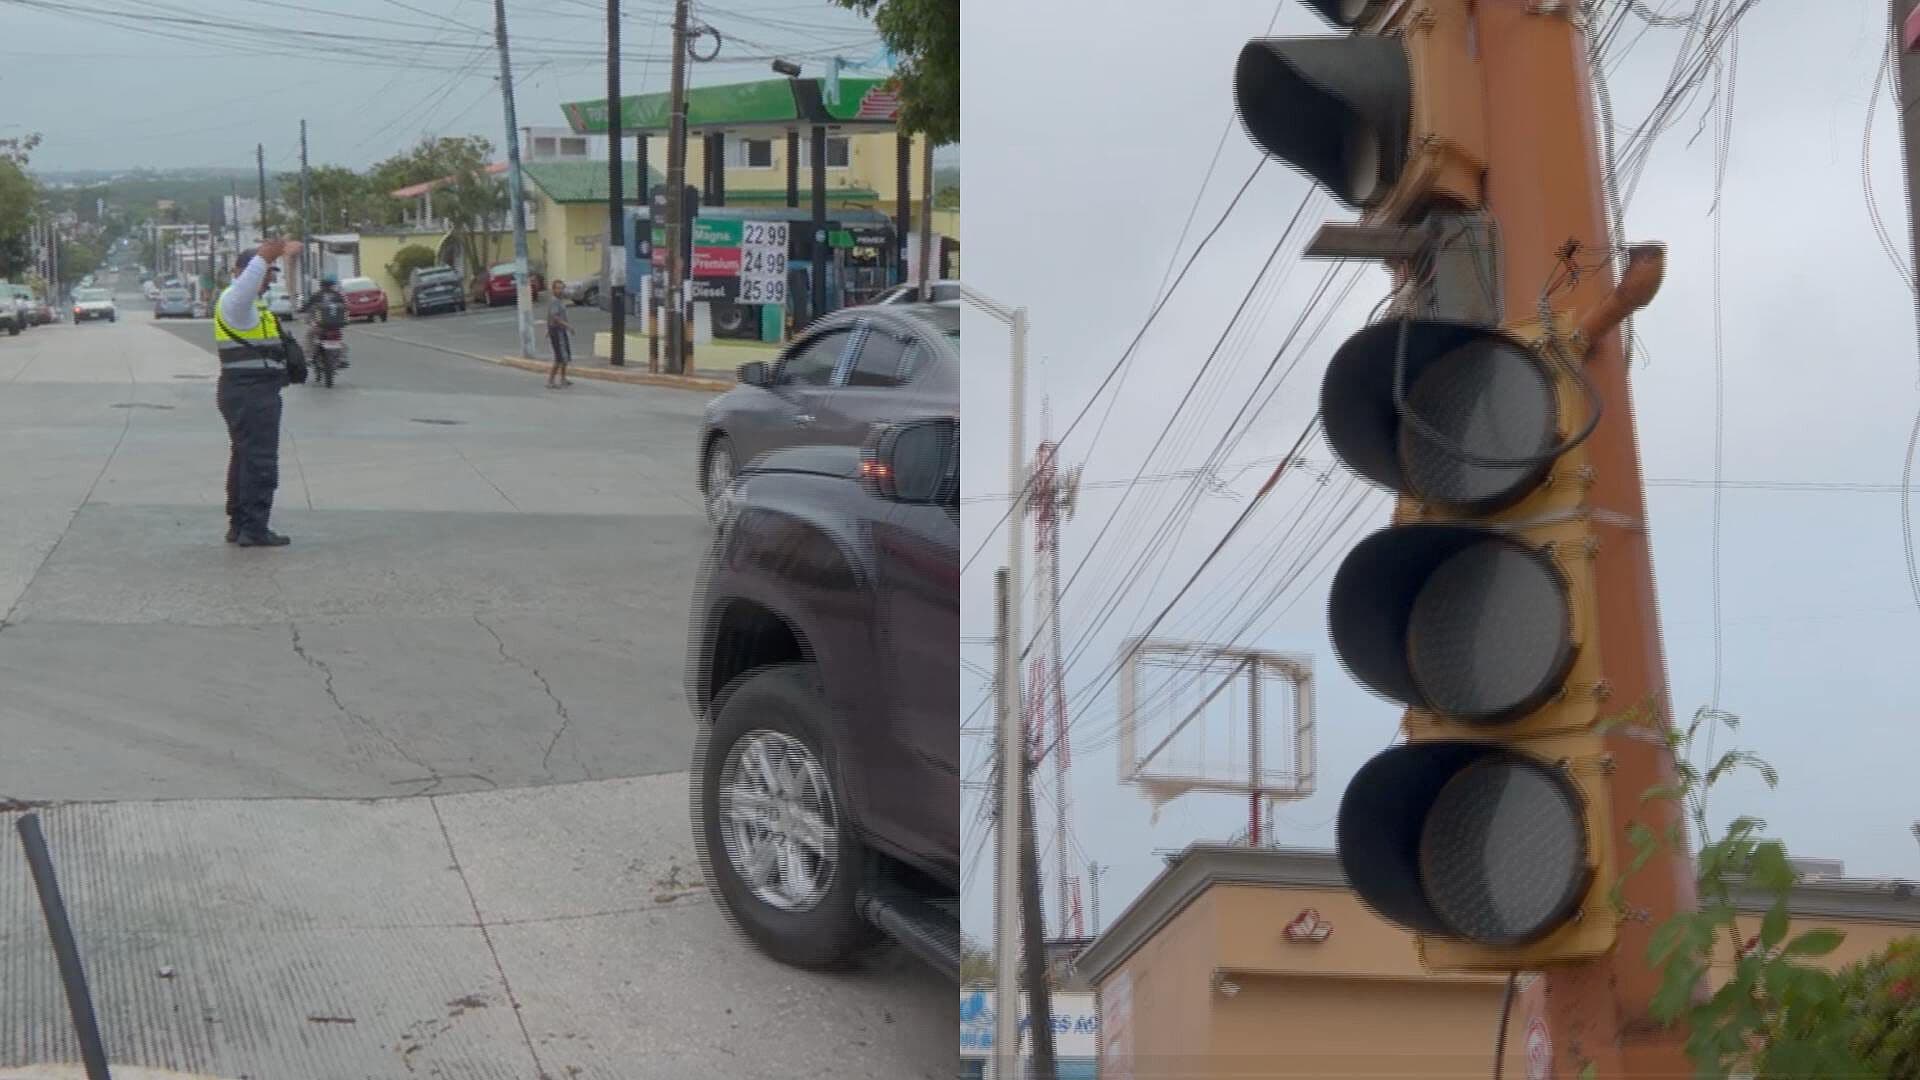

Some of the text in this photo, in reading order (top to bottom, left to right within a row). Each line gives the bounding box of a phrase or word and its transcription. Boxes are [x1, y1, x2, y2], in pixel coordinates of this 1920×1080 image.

[694, 229, 731, 243] Magna
[694, 257, 739, 270] Premium
[692, 285, 726, 297] Diesel
